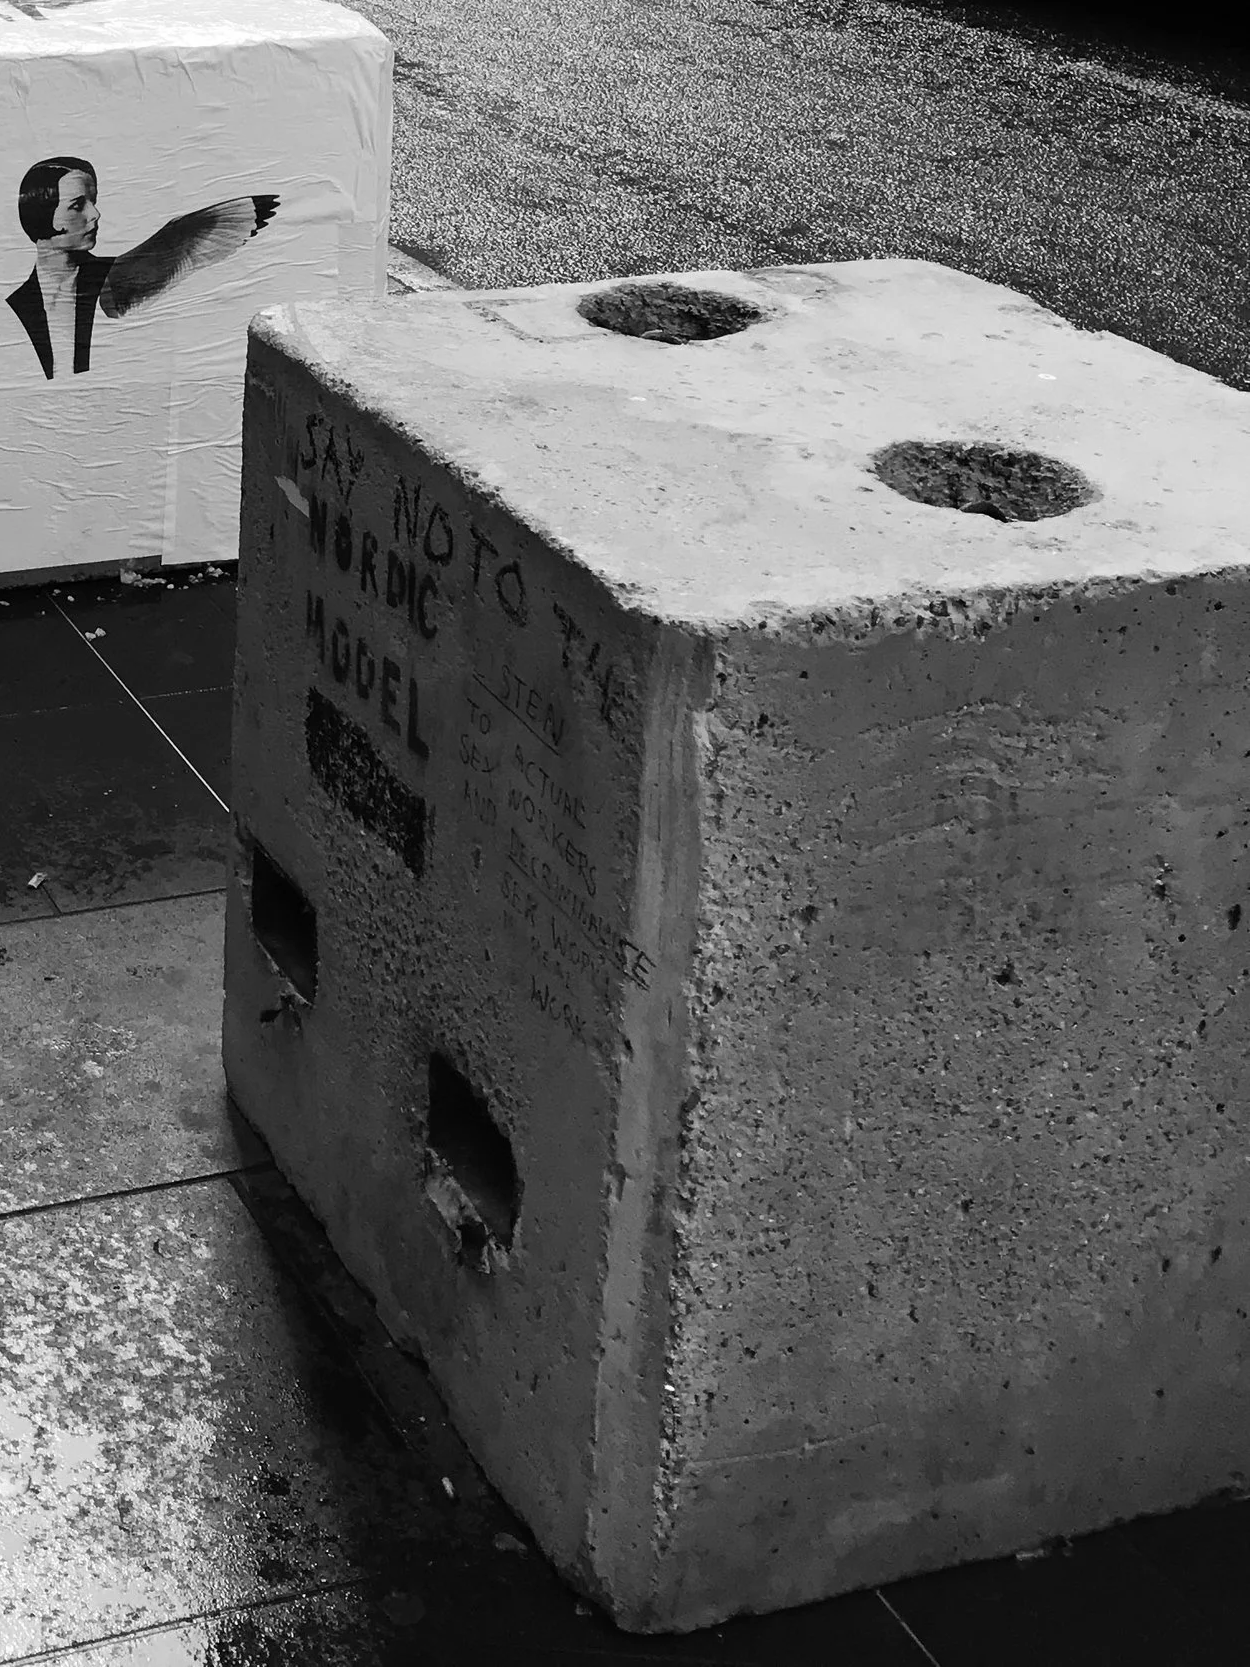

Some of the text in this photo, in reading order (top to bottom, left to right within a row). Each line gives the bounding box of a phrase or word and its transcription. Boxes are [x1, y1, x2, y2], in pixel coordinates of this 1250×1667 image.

[301, 413, 364, 504] SAY
[393, 475, 454, 568] NO
[469, 522, 527, 625] TO
[308, 494, 439, 640] NORDIC
[305, 589, 430, 760] MODEL
[466, 697, 587, 830] TO ACTUAL
[508, 787, 598, 898] WORKERS
